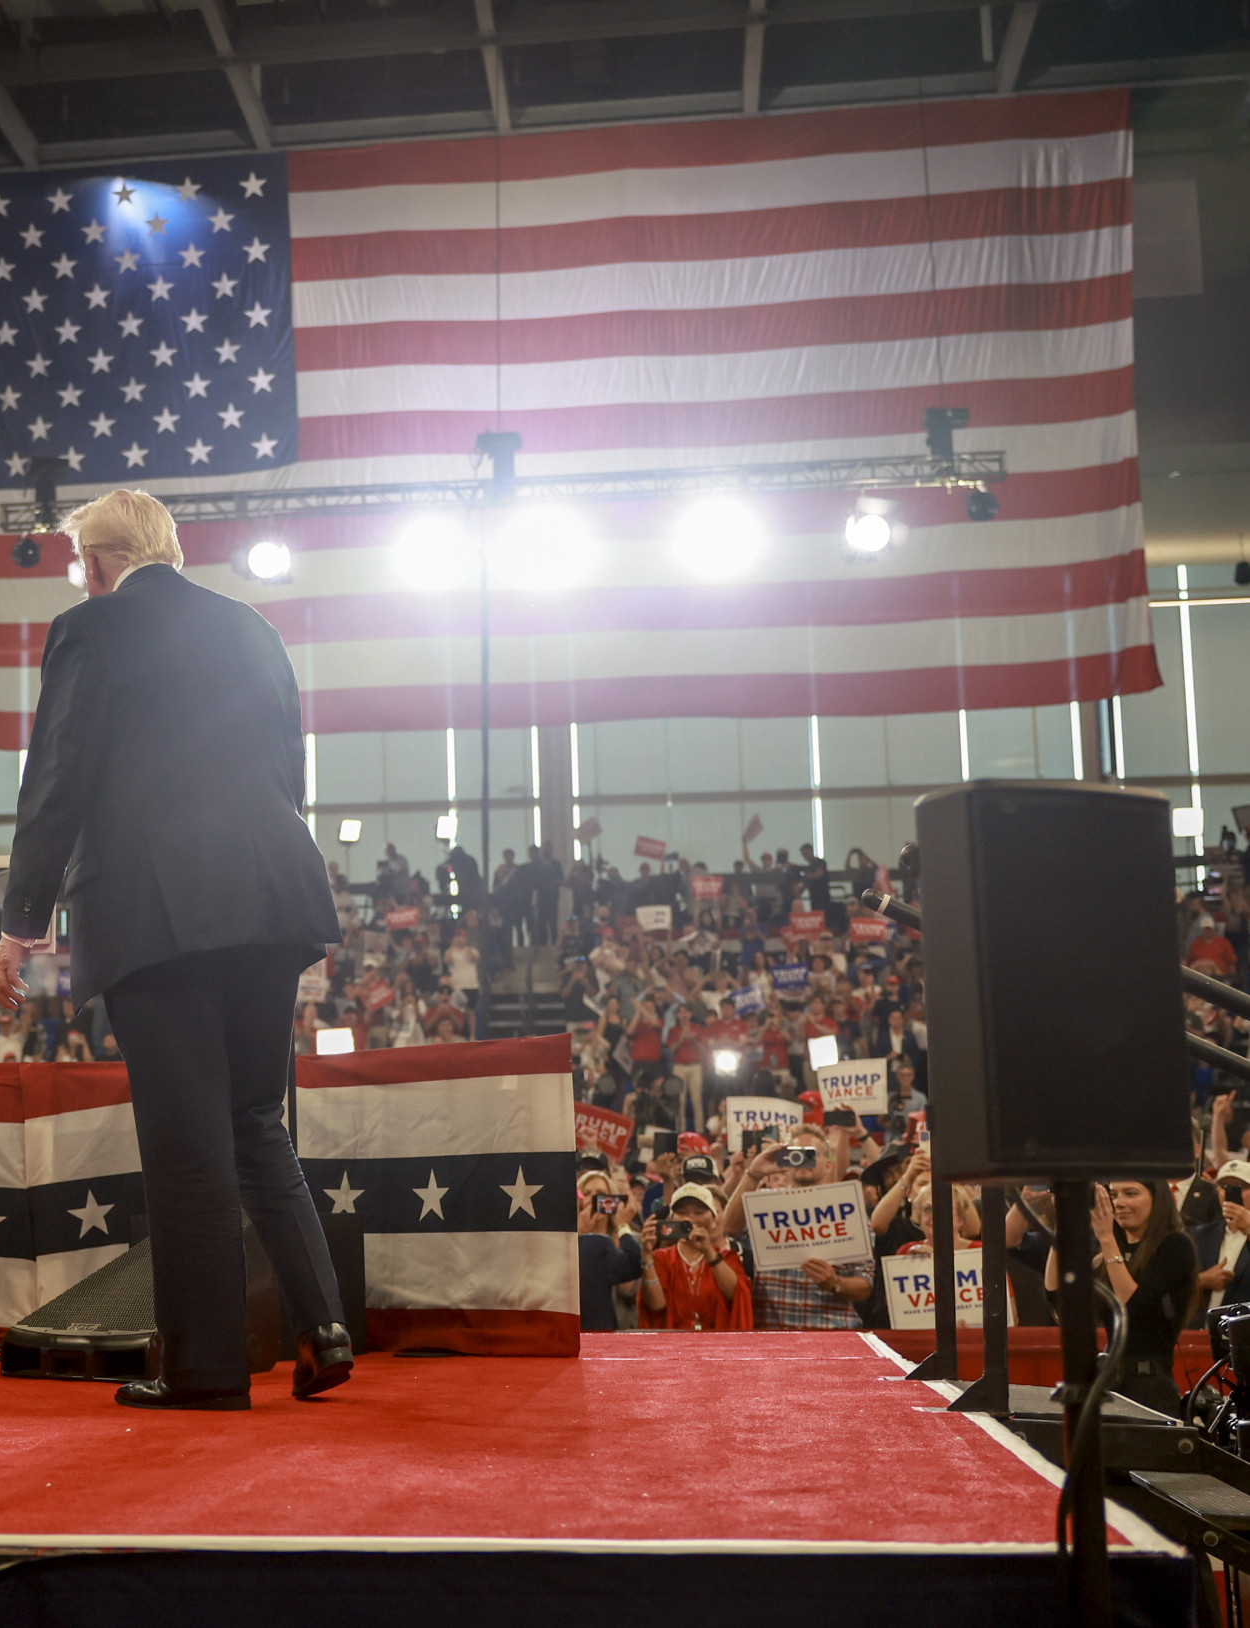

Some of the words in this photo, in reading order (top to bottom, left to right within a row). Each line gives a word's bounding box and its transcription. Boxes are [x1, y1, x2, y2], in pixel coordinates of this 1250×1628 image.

[822, 1073, 881, 1090] TRUMP
[827, 1086, 874, 1099] VANCE
[733, 1111, 799, 1126] TRUMP
[753, 1202, 856, 1230] TRUMP
[768, 1222, 848, 1244] VANCE
[892, 1268, 983, 1294] TRM
